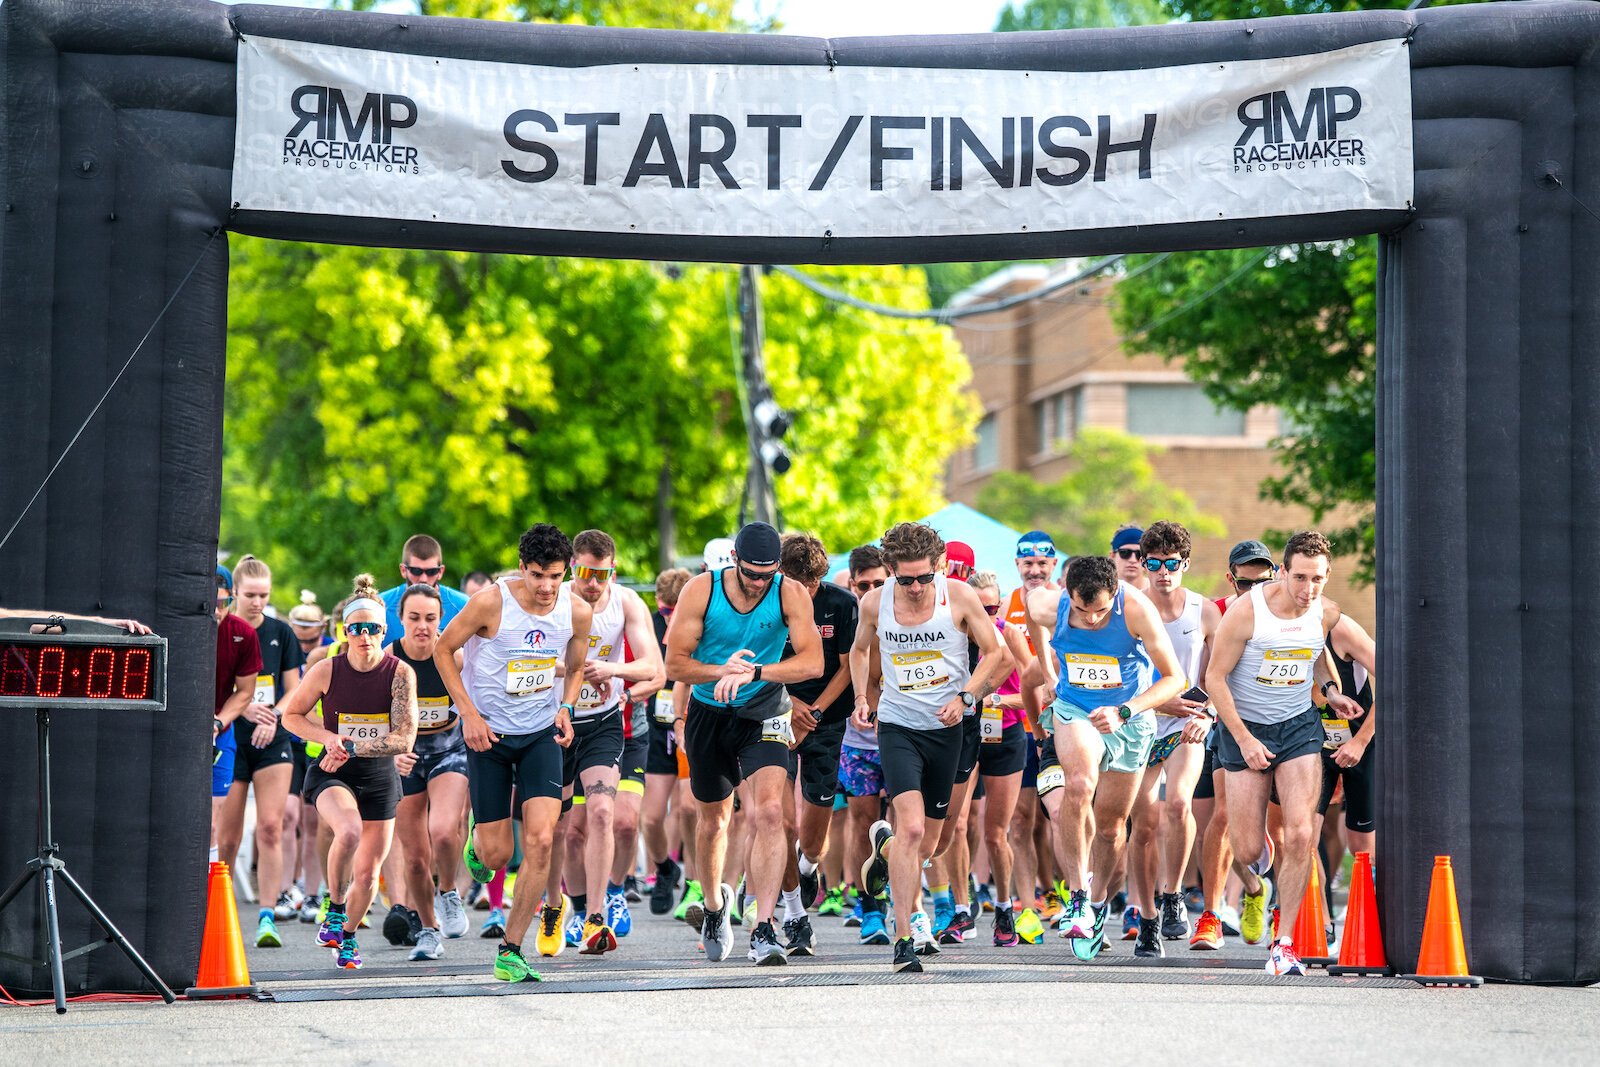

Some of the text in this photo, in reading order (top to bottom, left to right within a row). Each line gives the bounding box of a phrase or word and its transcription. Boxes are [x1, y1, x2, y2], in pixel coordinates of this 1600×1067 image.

[282, 138, 418, 166] RACEMAKER
[1233, 140, 1364, 165] RACEMAKER
[282, 156, 420, 175] PRODUCTIONS
[1234, 156, 1366, 174] PRODUCTIONS
[885, 631, 945, 643] INDIANA
[903, 665, 936, 681] 763
[1077, 667, 1109, 680] 783
[1269, 664, 1298, 677] 750
[516, 674, 544, 689] 790
[347, 727, 378, 738] 768
